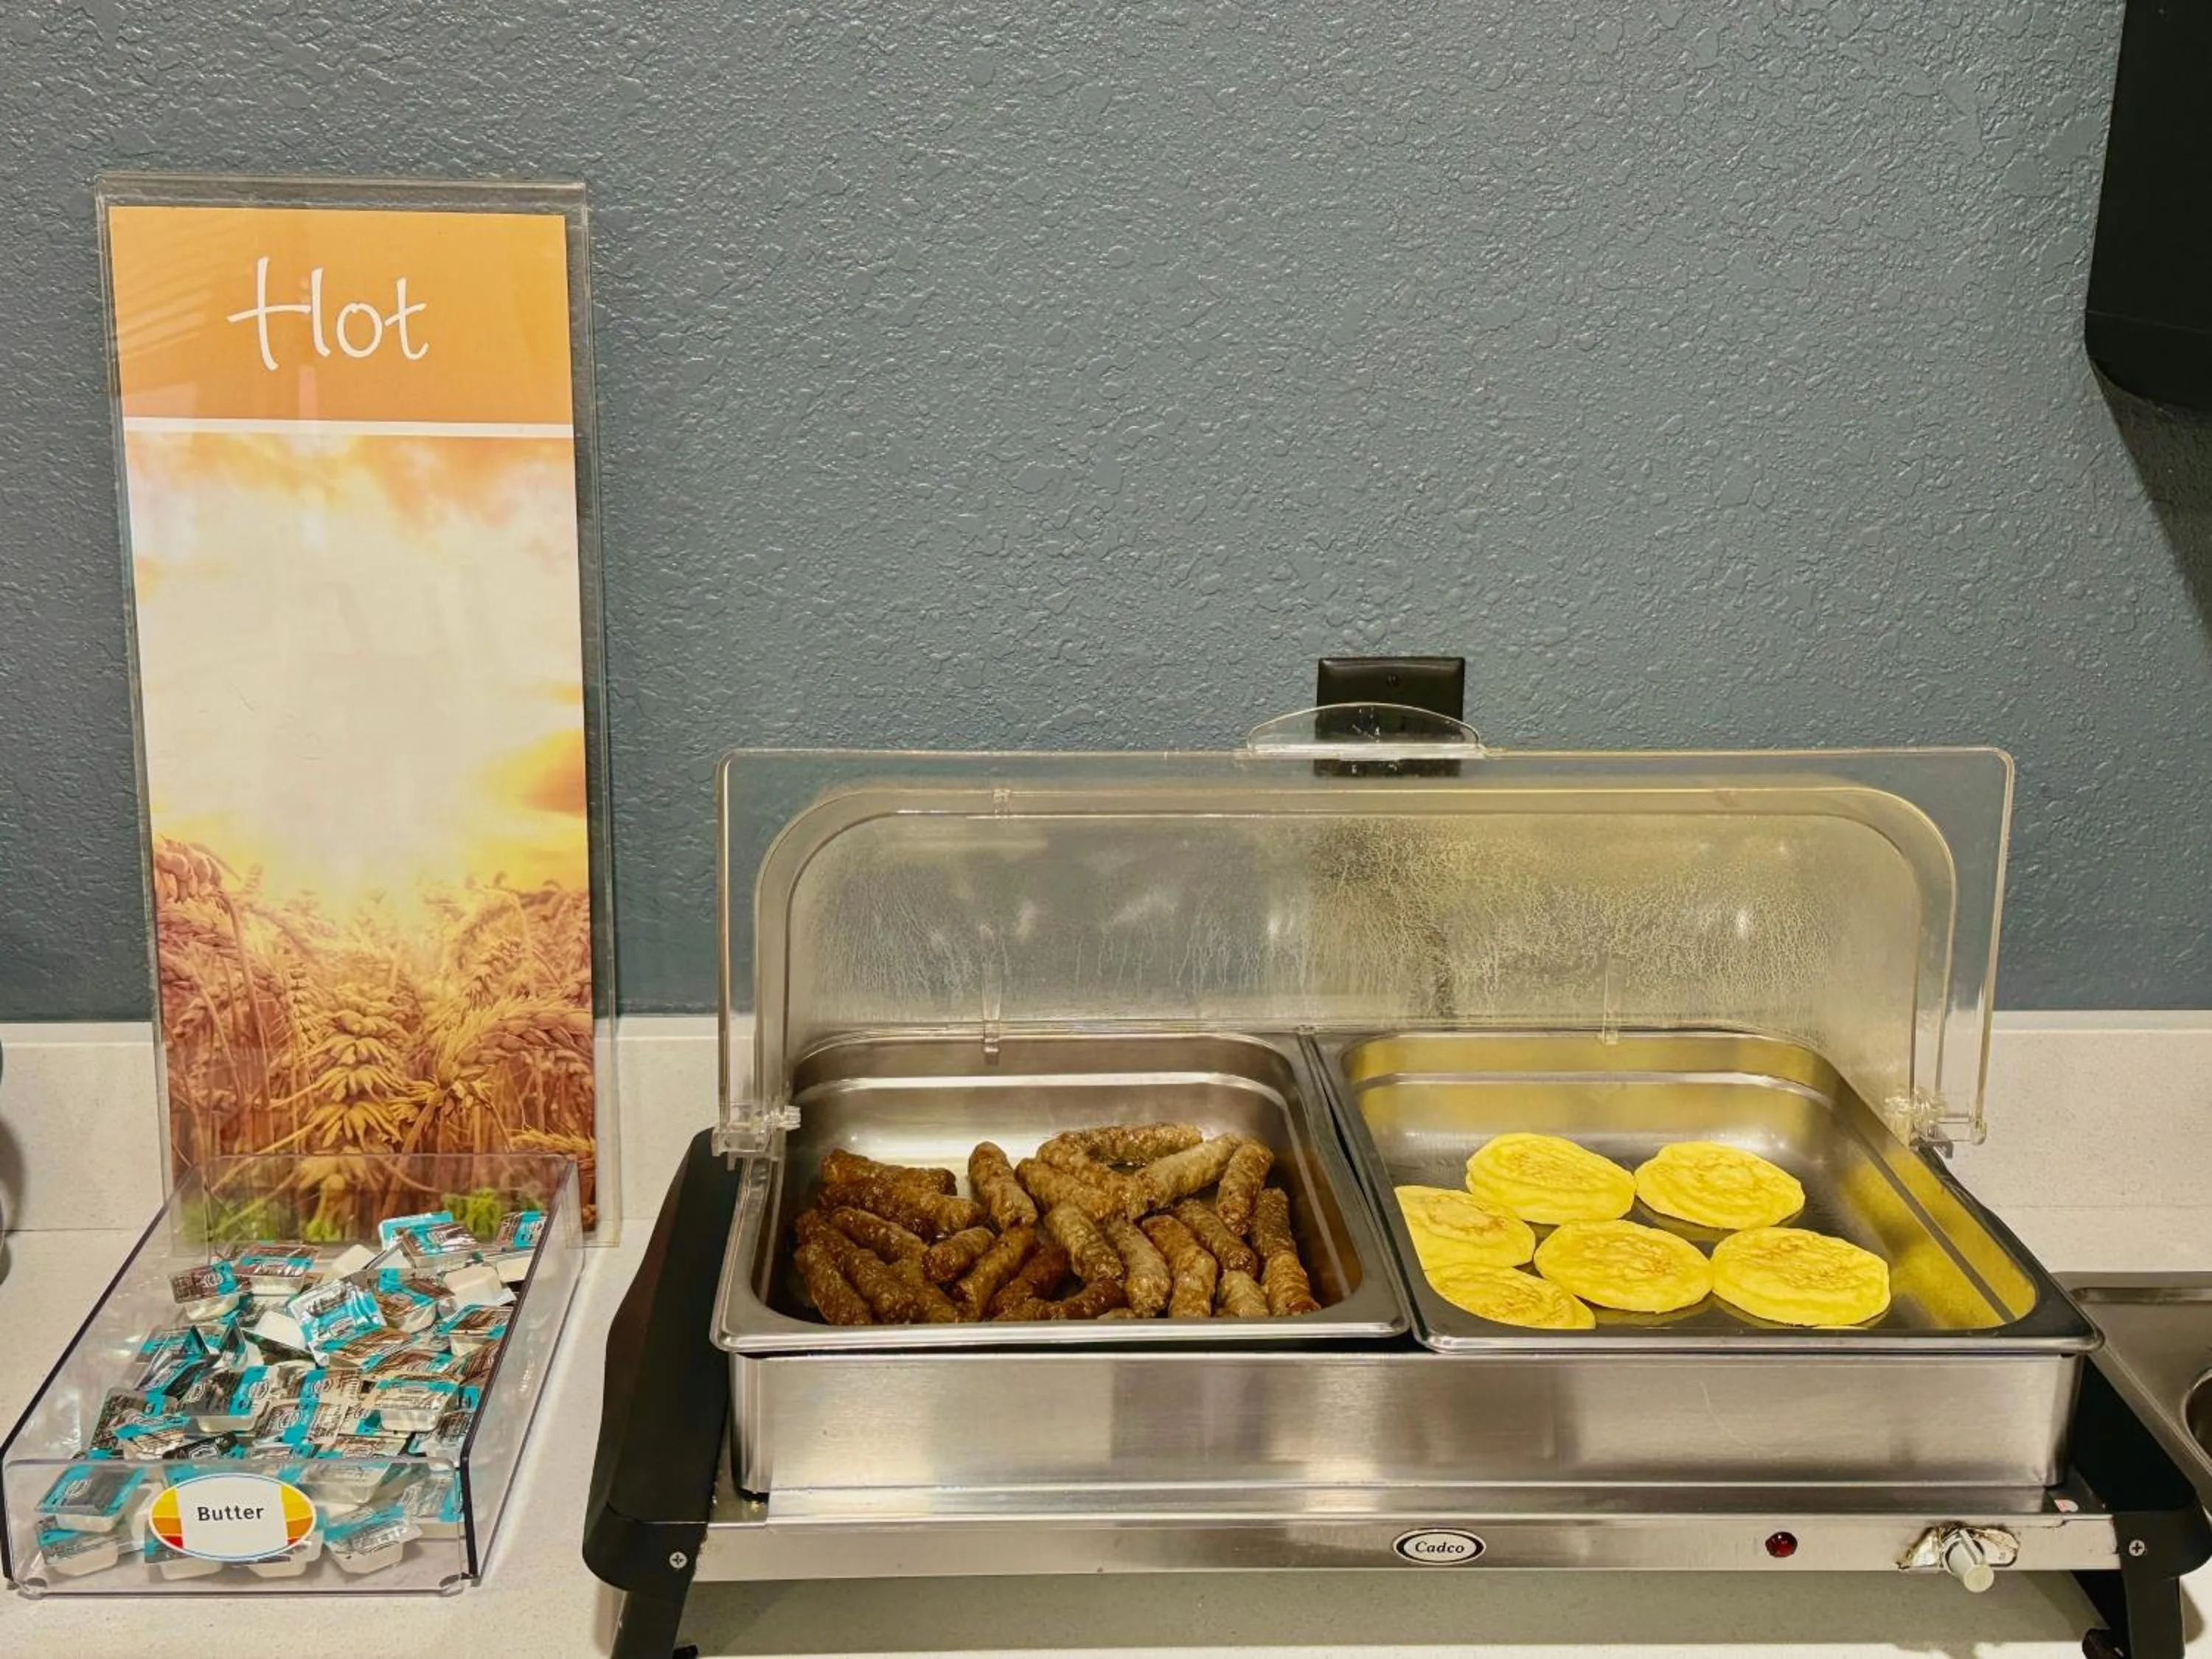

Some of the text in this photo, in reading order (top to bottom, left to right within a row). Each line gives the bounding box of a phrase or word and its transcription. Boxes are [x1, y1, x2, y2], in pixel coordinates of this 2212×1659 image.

[226, 255, 429, 371] Hot
[197, 1505, 264, 1521] Butter
[1414, 1540, 1465, 1554] Cadco
